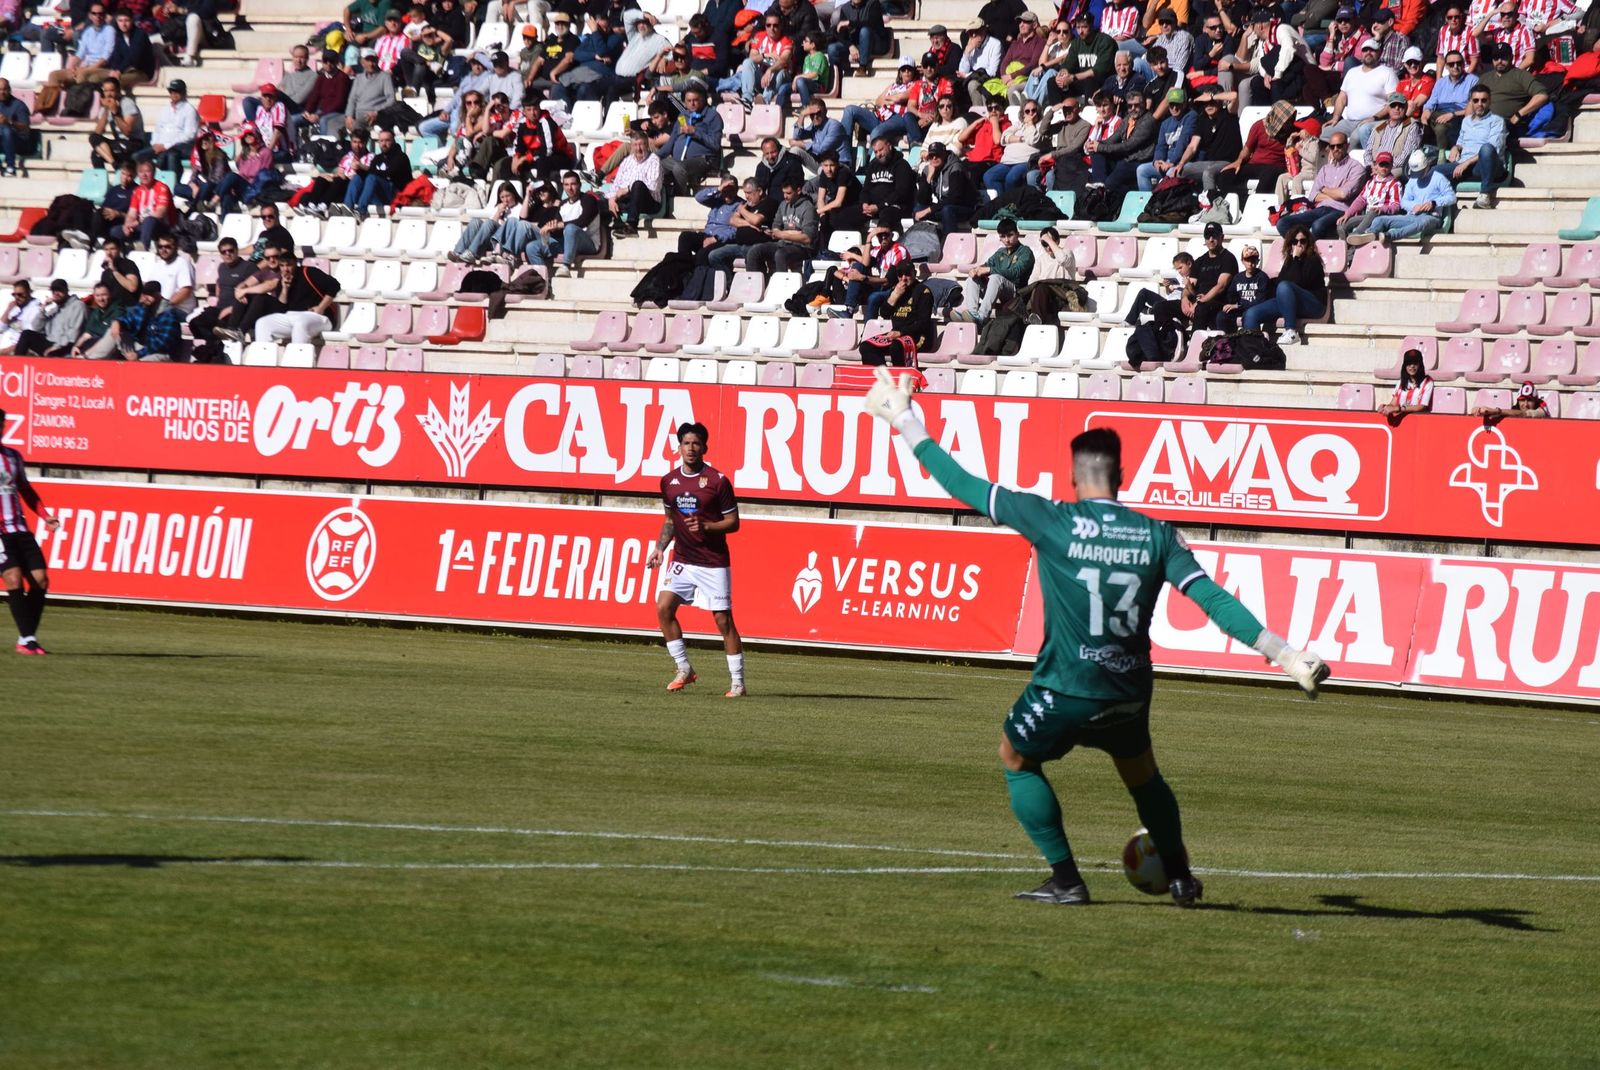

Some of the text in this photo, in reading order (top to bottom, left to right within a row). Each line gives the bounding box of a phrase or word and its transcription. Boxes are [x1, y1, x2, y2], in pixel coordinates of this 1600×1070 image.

[47, 373, 91, 388] Donantes
[92, 375, 104, 388] de
[34, 393, 67, 410] Sangre
[82, 396, 106, 410] Local
[107, 397, 115, 410] A
[126, 395, 251, 421] CARPINTERÍA
[33, 413, 76, 429] ZAMORA
[164, 420, 250, 443] HIJOS DE
[32, 435, 50, 448] 980
[51, 436, 63, 448] 04
[77, 438, 89, 450] 23
[504, 382, 1053, 500] CAJA RURAL
[1117, 419, 1361, 514] AMAQ
[1149, 488, 1272, 510] ALQUILERES
[1067, 541, 1151, 566] MARQUETA
[832, 556, 982, 601] VERSUS
[841, 598, 960, 622] E-LEARNING
[1075, 567, 1142, 637] 13
[1420, 562, 1600, 687] RU
